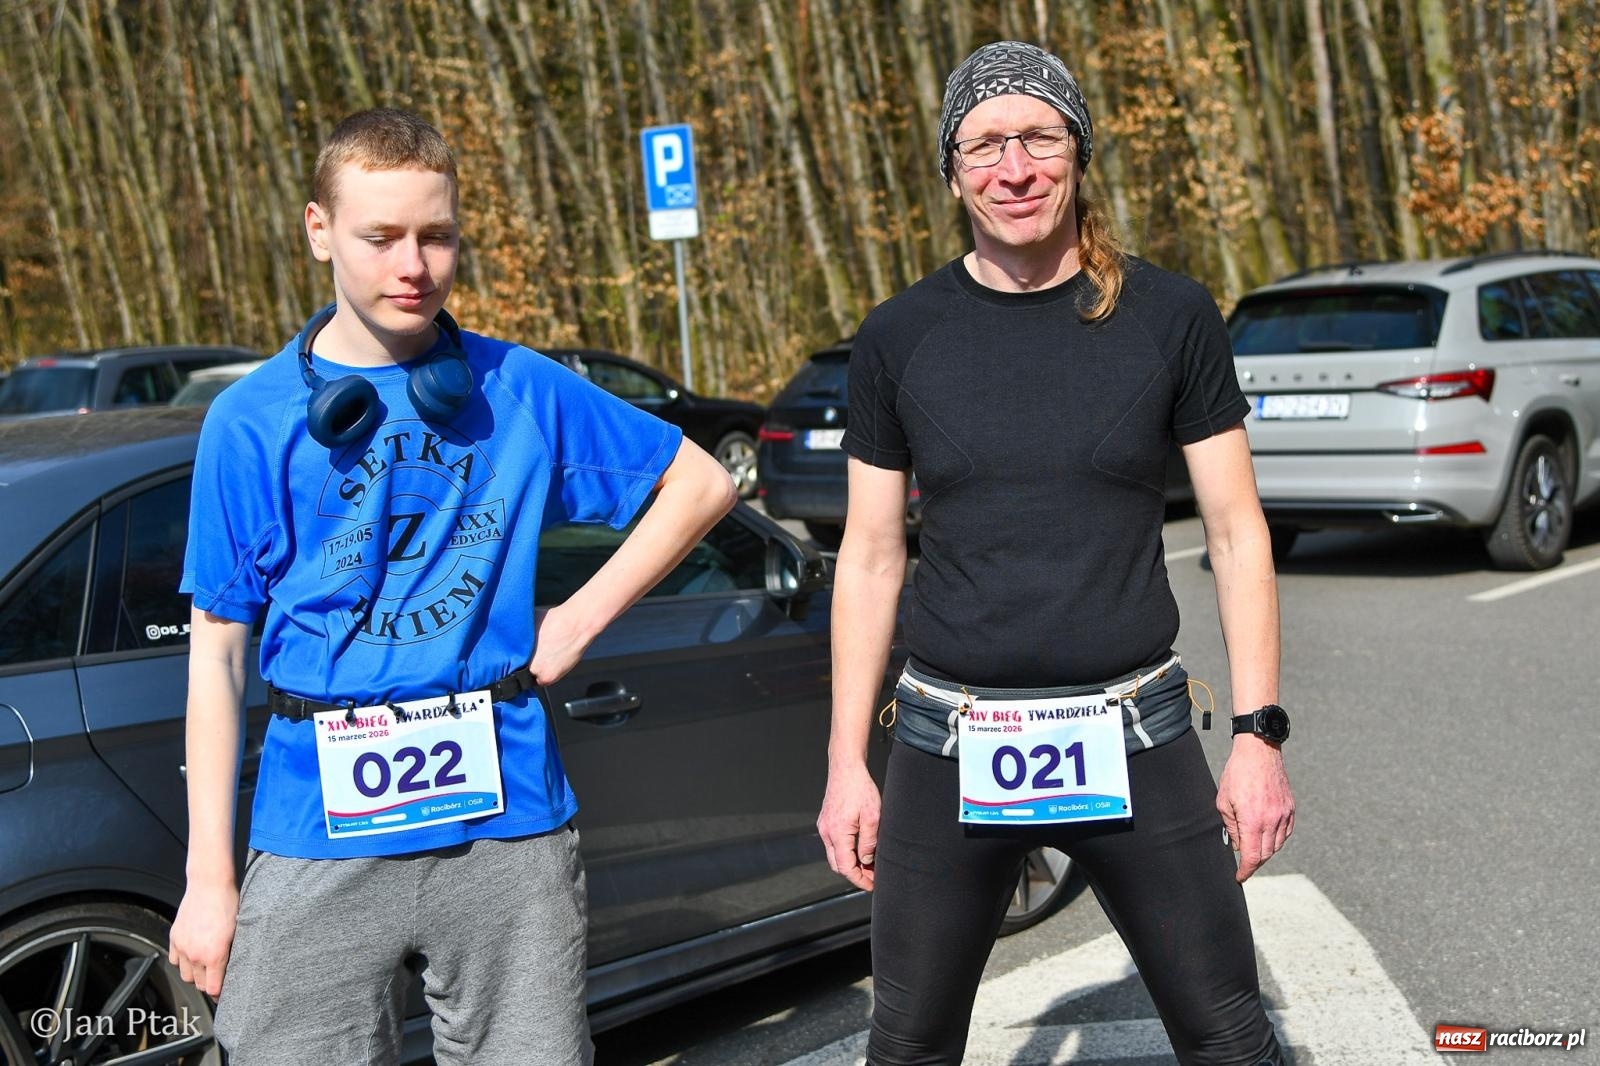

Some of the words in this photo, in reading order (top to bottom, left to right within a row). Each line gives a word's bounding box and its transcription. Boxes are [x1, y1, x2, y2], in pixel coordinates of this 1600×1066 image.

[652, 132, 683, 188] P
[338, 432, 475, 508] SETKA
[328, 527, 374, 556] 17-19.05
[386, 512, 426, 562] Z
[451, 527, 502, 546] EDYCJA
[335, 552, 363, 571] 2024
[355, 714, 388, 729] BIEG
[968, 710, 988, 722] XIV
[992, 710, 1022, 723] BIEG
[1028, 705, 1108, 721] TWARDZIELA
[338, 733, 367, 742] marzec
[368, 729, 390, 738] 2026
[1003, 725, 1023, 733] 2026
[352, 740, 467, 798] 022
[991, 741, 1087, 791] 021
[430, 802, 462, 814] Racibórz
